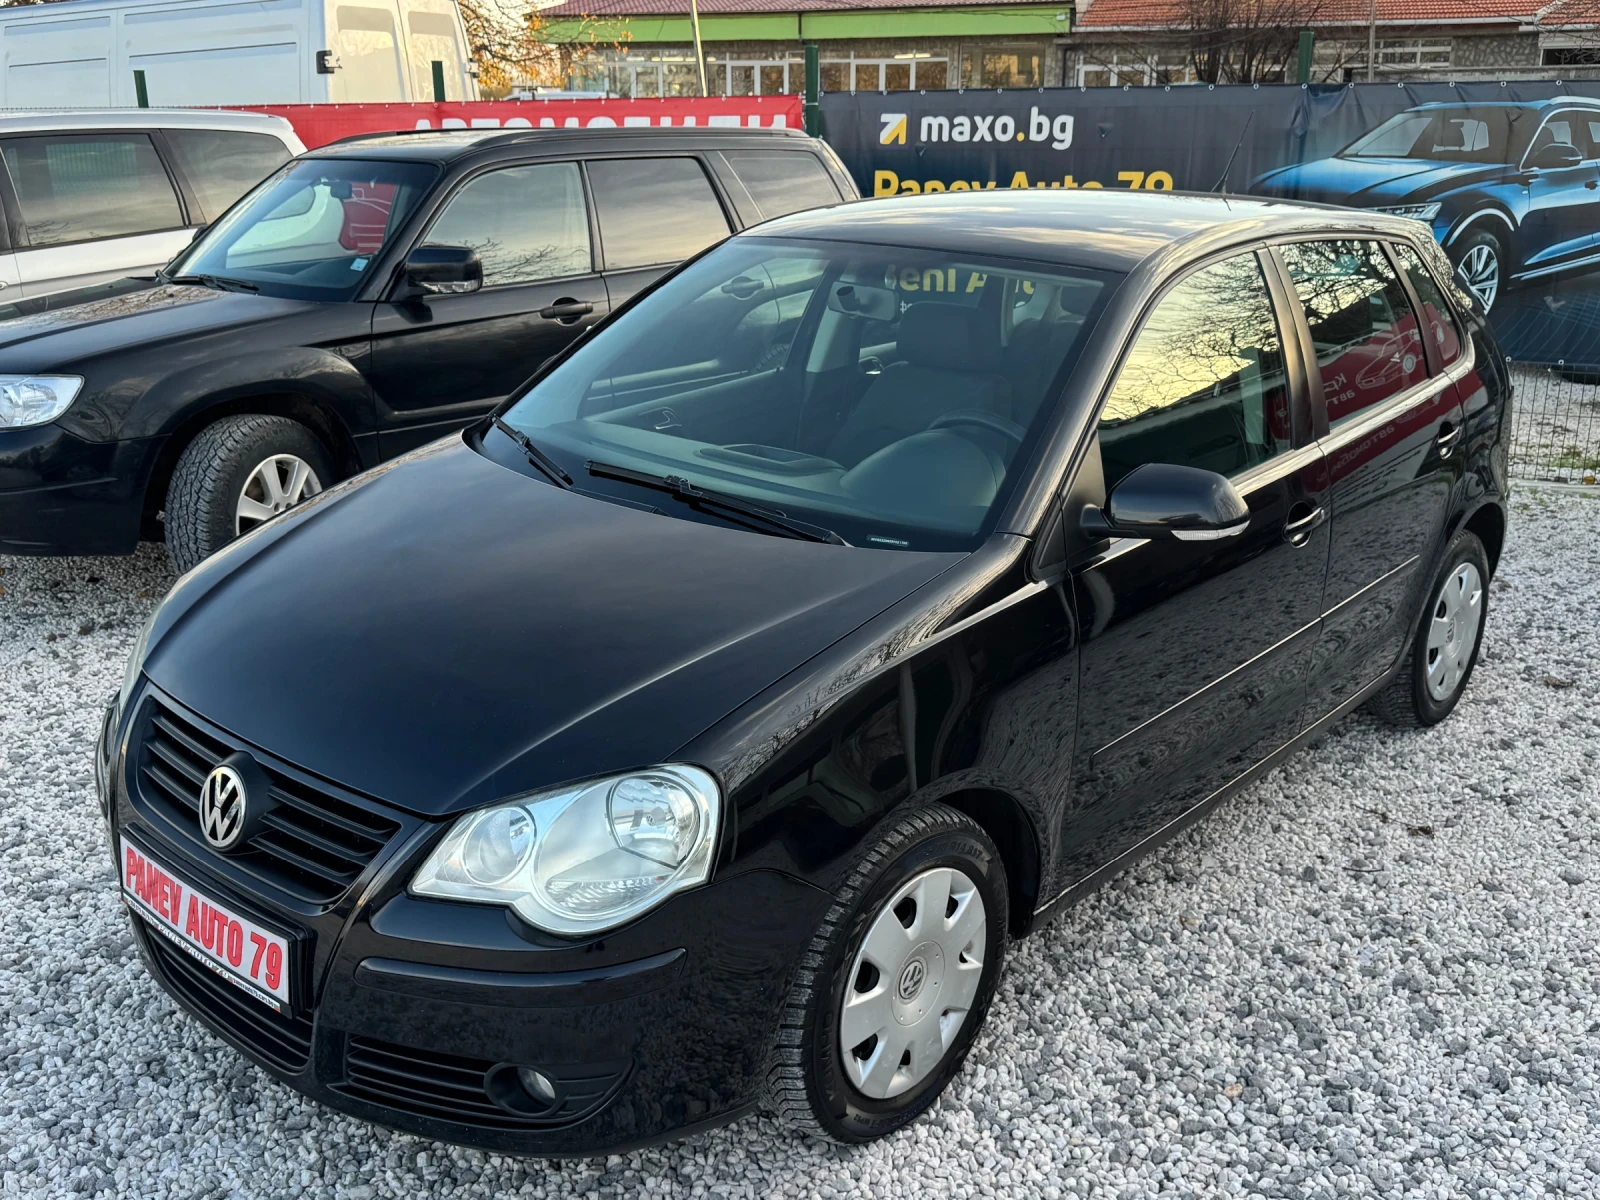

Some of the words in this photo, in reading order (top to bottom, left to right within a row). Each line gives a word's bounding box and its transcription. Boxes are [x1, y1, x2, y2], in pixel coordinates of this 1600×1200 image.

[920, 106, 1074, 150] maxo.bg
[1010, 171, 1104, 189] At
[1117, 170, 1174, 190] 79
[199, 766, 246, 847] VW
[126, 846, 183, 927] PANEV
[186, 893, 243, 967] AUTO
[250, 931, 283, 990] 79
[187, 946, 214, 969] AUTO
